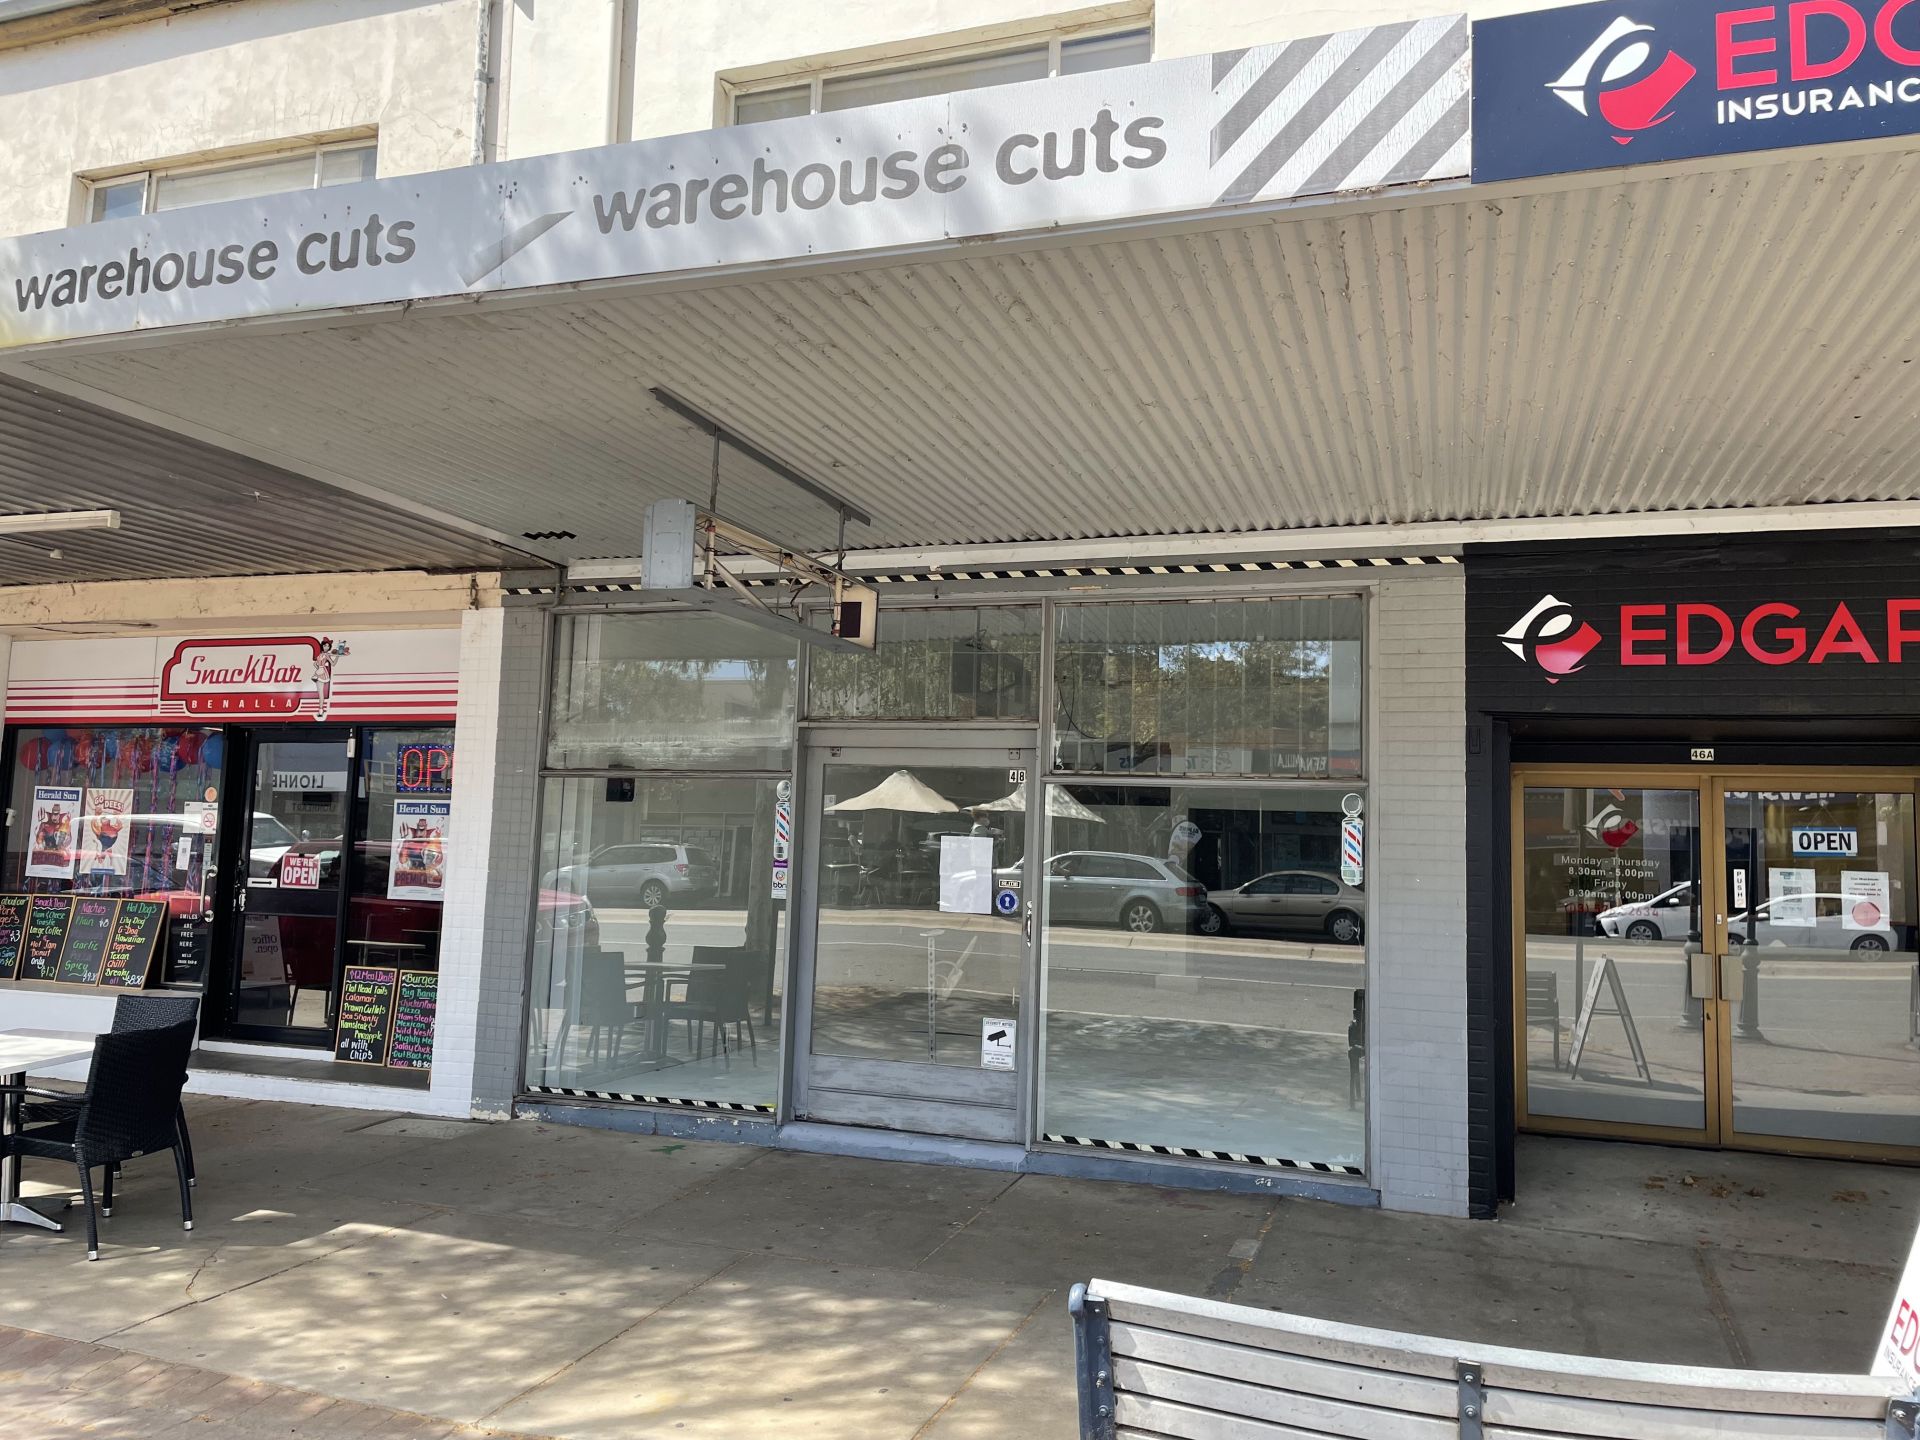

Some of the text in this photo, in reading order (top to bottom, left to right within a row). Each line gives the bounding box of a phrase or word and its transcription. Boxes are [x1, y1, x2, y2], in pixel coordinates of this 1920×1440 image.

[593, 109, 1167, 234] warehouse cuts
[16, 213, 417, 313] warehouse cuts
[192, 699, 292, 709] BENALLA
[1691, 750, 1714, 761] 46A
[402, 749, 455, 788] OP
[1009, 770, 1026, 783] 48
[38, 790, 77, 800] Herald Sun
[94, 795, 104, 805] GO
[399, 804, 448, 815] Herald Sun
[1799, 832, 1852, 851] OPEN
[290, 857, 314, 866] WE'RE
[1561, 855, 1602, 867] Monday
[1612, 856, 1660, 868] Thursday
[283, 867, 318, 885] OPEN
[1568, 867, 1606, 877] 8.30am
[1615, 868, 1654, 879] 5.00pm
[1594, 879, 1628, 890] Friday
[1736, 871, 1744, 898] PUSH
[1568, 889, 1607, 899] 8.30am
[35, 898, 53, 907] Snack
[82, 902, 106, 913] Nachos
[126, 902, 137, 913] Hot
[133, 917, 145, 929] Dog
[30, 926, 63, 938] Large Coffee
[73, 940, 98, 951] Garlic
[110, 952, 130, 960] Texan
[64, 960, 88, 971] Spicy
[107, 960, 126, 968] Chilli
[357, 984, 372, 994] Head
[401, 988, 414, 999] Big
[345, 993, 377, 1003] Calamari
[344, 1002, 364, 1012] Prawn
[342, 1012, 353, 1020] Sea
[398, 1013, 414, 1021] Ham
[396, 1020, 425, 1029] Mexican
[395, 1027, 411, 1035] Wild
[340, 1039, 368, 1050] all with
[395, 1033, 420, 1045] Mighty
[393, 1059, 408, 1067] Taco
[1891, 1298, 1920, 1375] ED
